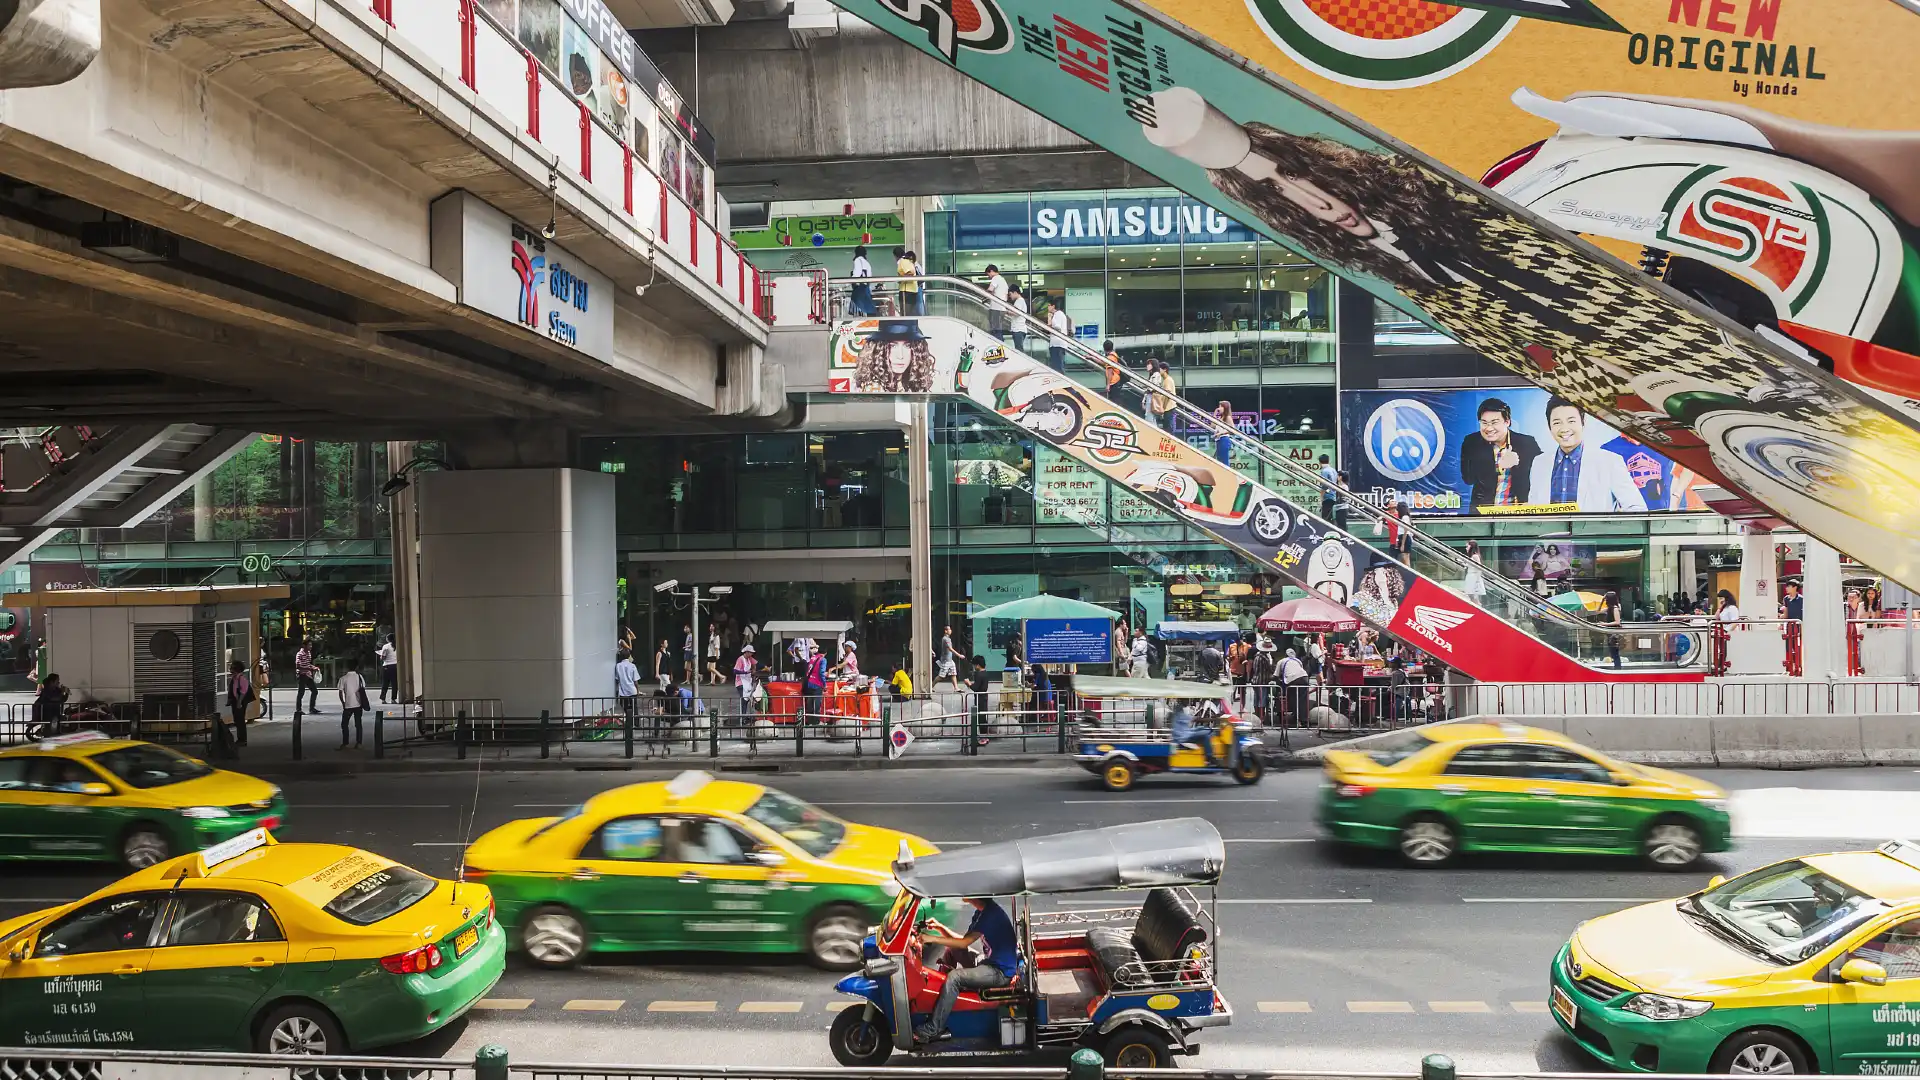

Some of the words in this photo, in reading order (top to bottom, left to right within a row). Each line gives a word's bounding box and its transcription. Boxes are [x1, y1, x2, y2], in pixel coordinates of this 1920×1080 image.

[569, 0, 631, 74] OFFEE
[1018, 15, 1057, 63] THE
[1052, 13, 1110, 93] NEW
[1151, 44, 1171, 74] Honda
[1627, 32, 1826, 81] ORIGINAL
[1104, 14, 1158, 129] ORIGINAL
[1156, 70, 1175, 87] by
[1733, 80, 1749, 97] by
[1756, 80, 1798, 96] Honda
[798, 215, 904, 234] gateway
[1036, 205, 1228, 239] SAMSUNG
[549, 262, 589, 313] สยาม
[548, 310, 577, 347] Siam
[1075, 424, 1140, 453] S12
[1158, 443, 1177, 453] NEW
[1290, 448, 1313, 460] AD
[1045, 465, 1073, 473] LIGHT
[1276, 479, 1296, 487] FOR
[1047, 481, 1068, 489] FOR
[1070, 481, 1095, 489] RENT
[53, 581, 77, 590] iPhone
[77, 581, 83, 590] 5
[1404, 617, 1453, 653] HONDA
[71, 1002, 96, 1014] 6159
